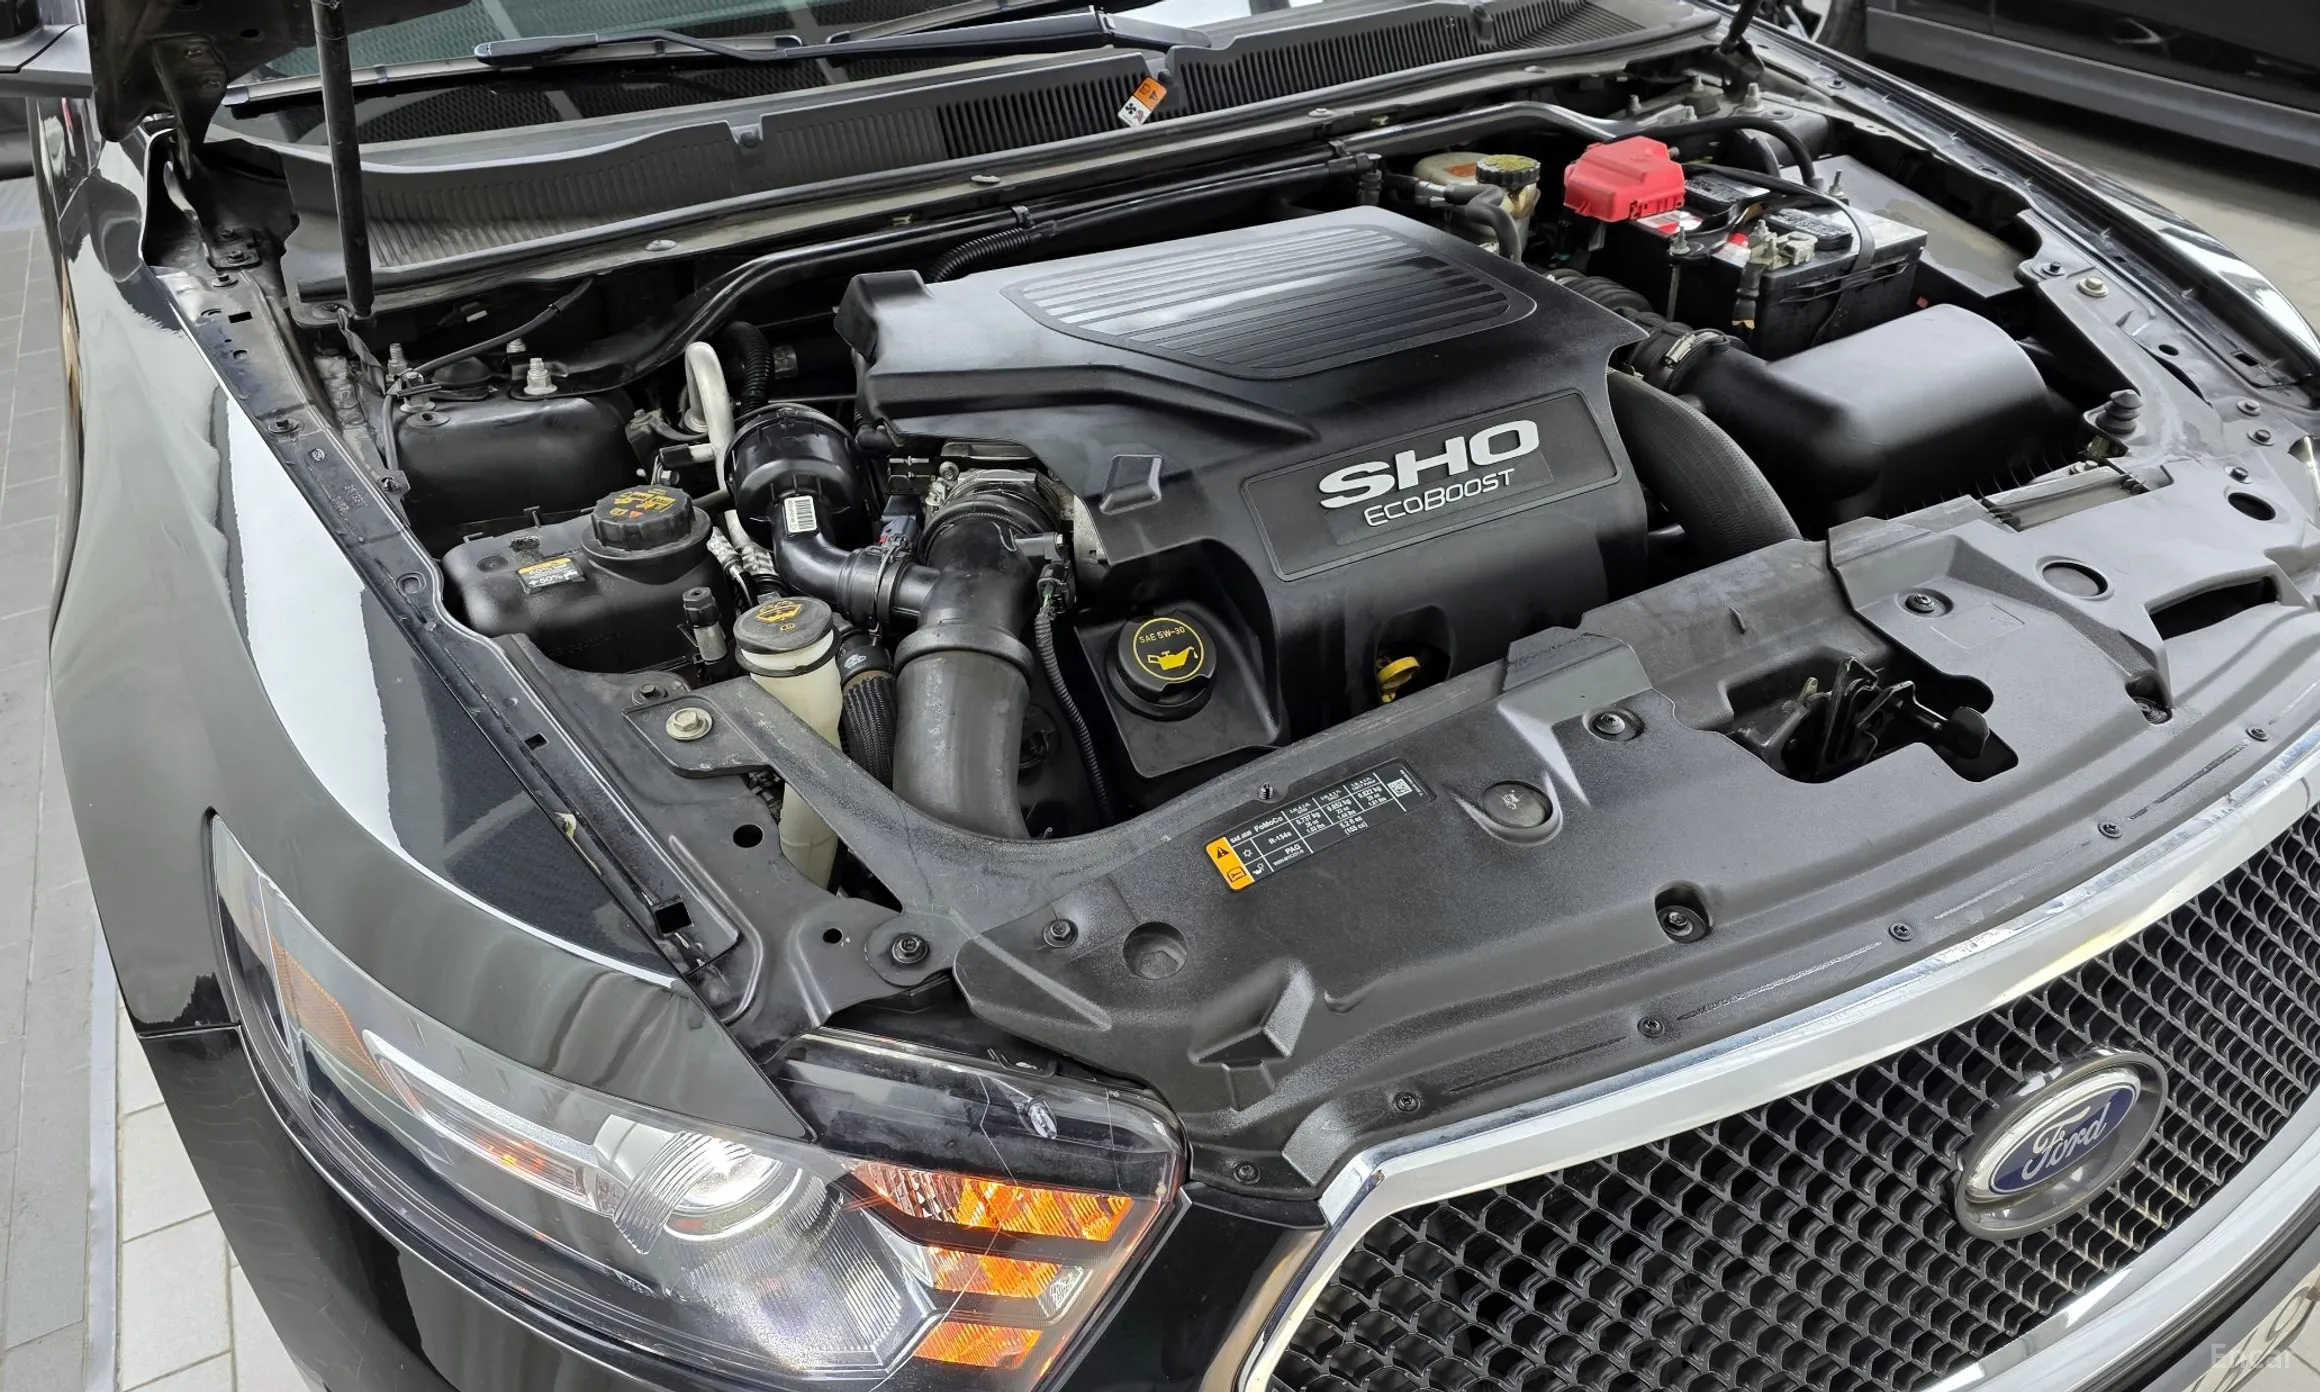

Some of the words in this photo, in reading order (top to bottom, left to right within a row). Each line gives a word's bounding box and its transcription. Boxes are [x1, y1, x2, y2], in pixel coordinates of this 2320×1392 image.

[1319, 419, 1540, 509] SHO
[1139, 632, 1157, 644] SAE
[1157, 626, 1185, 639] 5W-30
[1254, 816, 1284, 833] FoMoCo
[1268, 831, 1292, 845] R-134a
[1284, 844, 1301, 855] PAG
[2021, 1101, 2112, 1181] Ford
